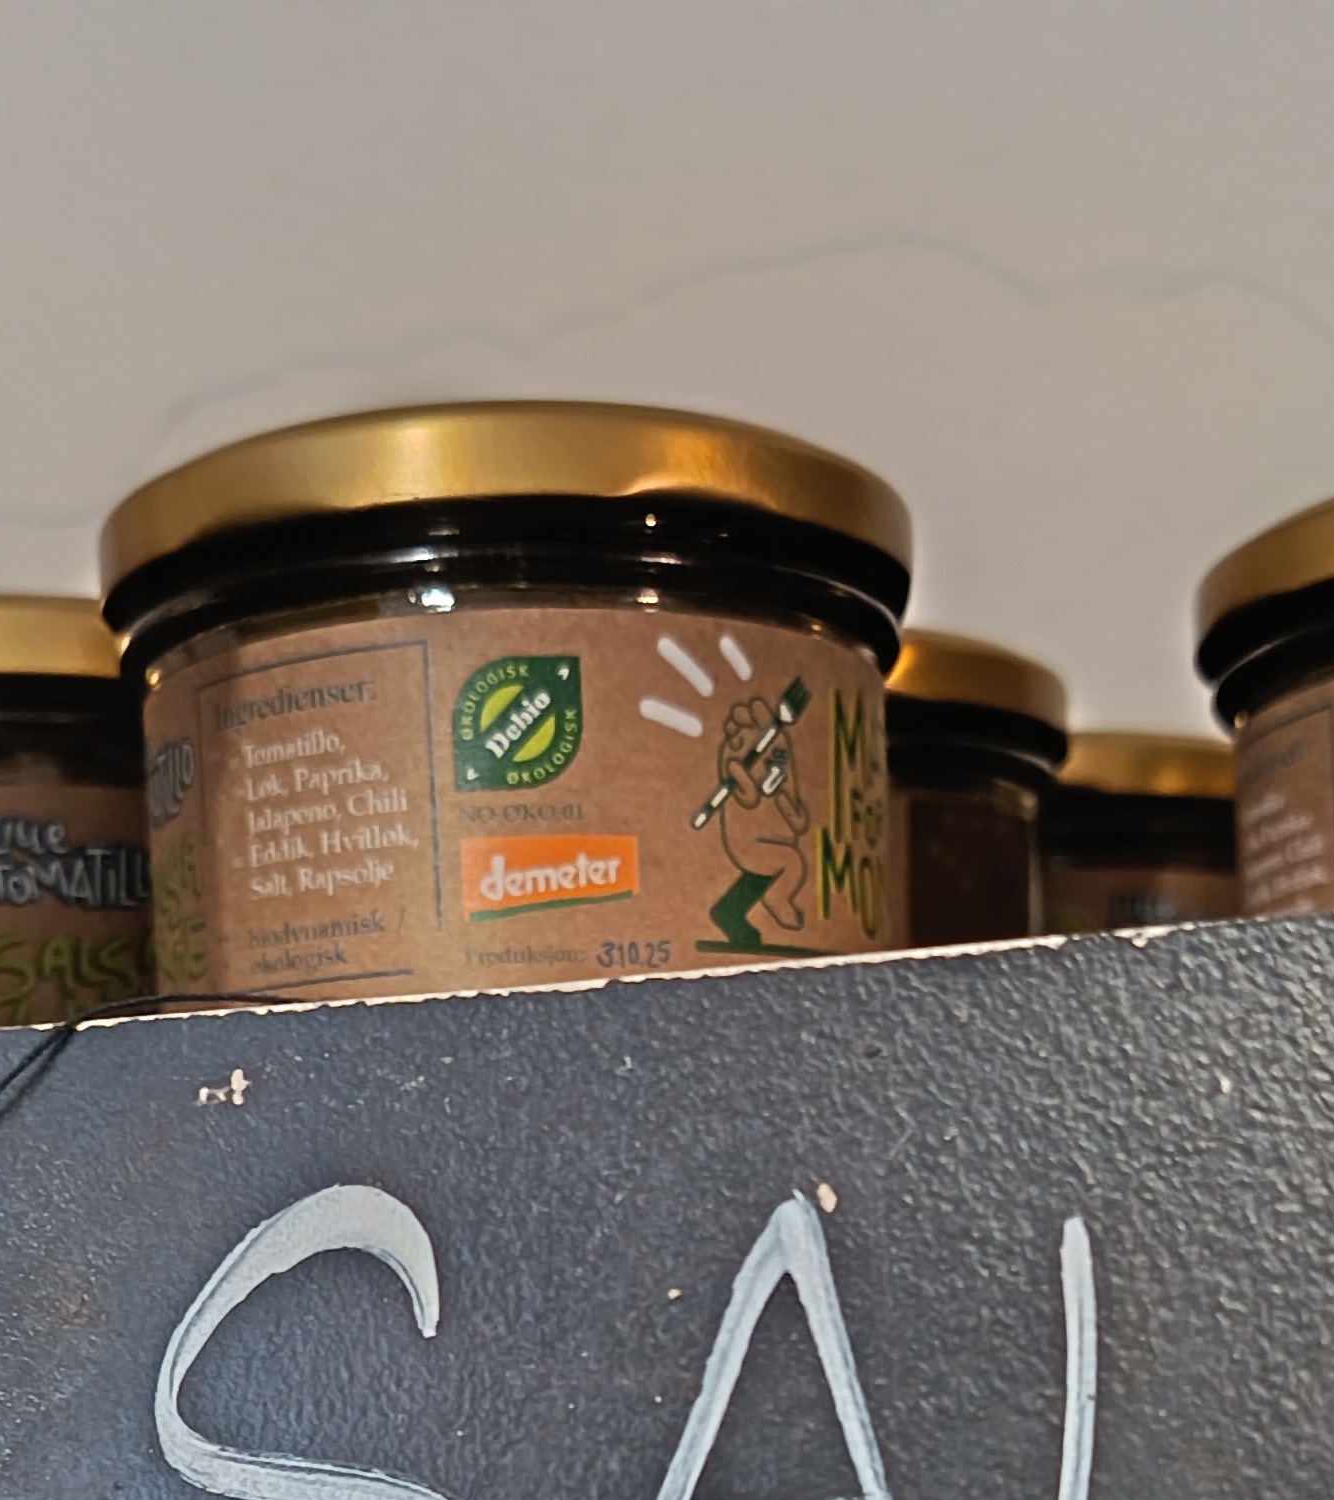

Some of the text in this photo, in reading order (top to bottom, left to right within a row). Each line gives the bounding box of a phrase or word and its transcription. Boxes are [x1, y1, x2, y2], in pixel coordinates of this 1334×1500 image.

[485, 692, 551, 759] Debio
[347, 789, 408, 817] Chili
[480, 853, 621, 901] demeter
